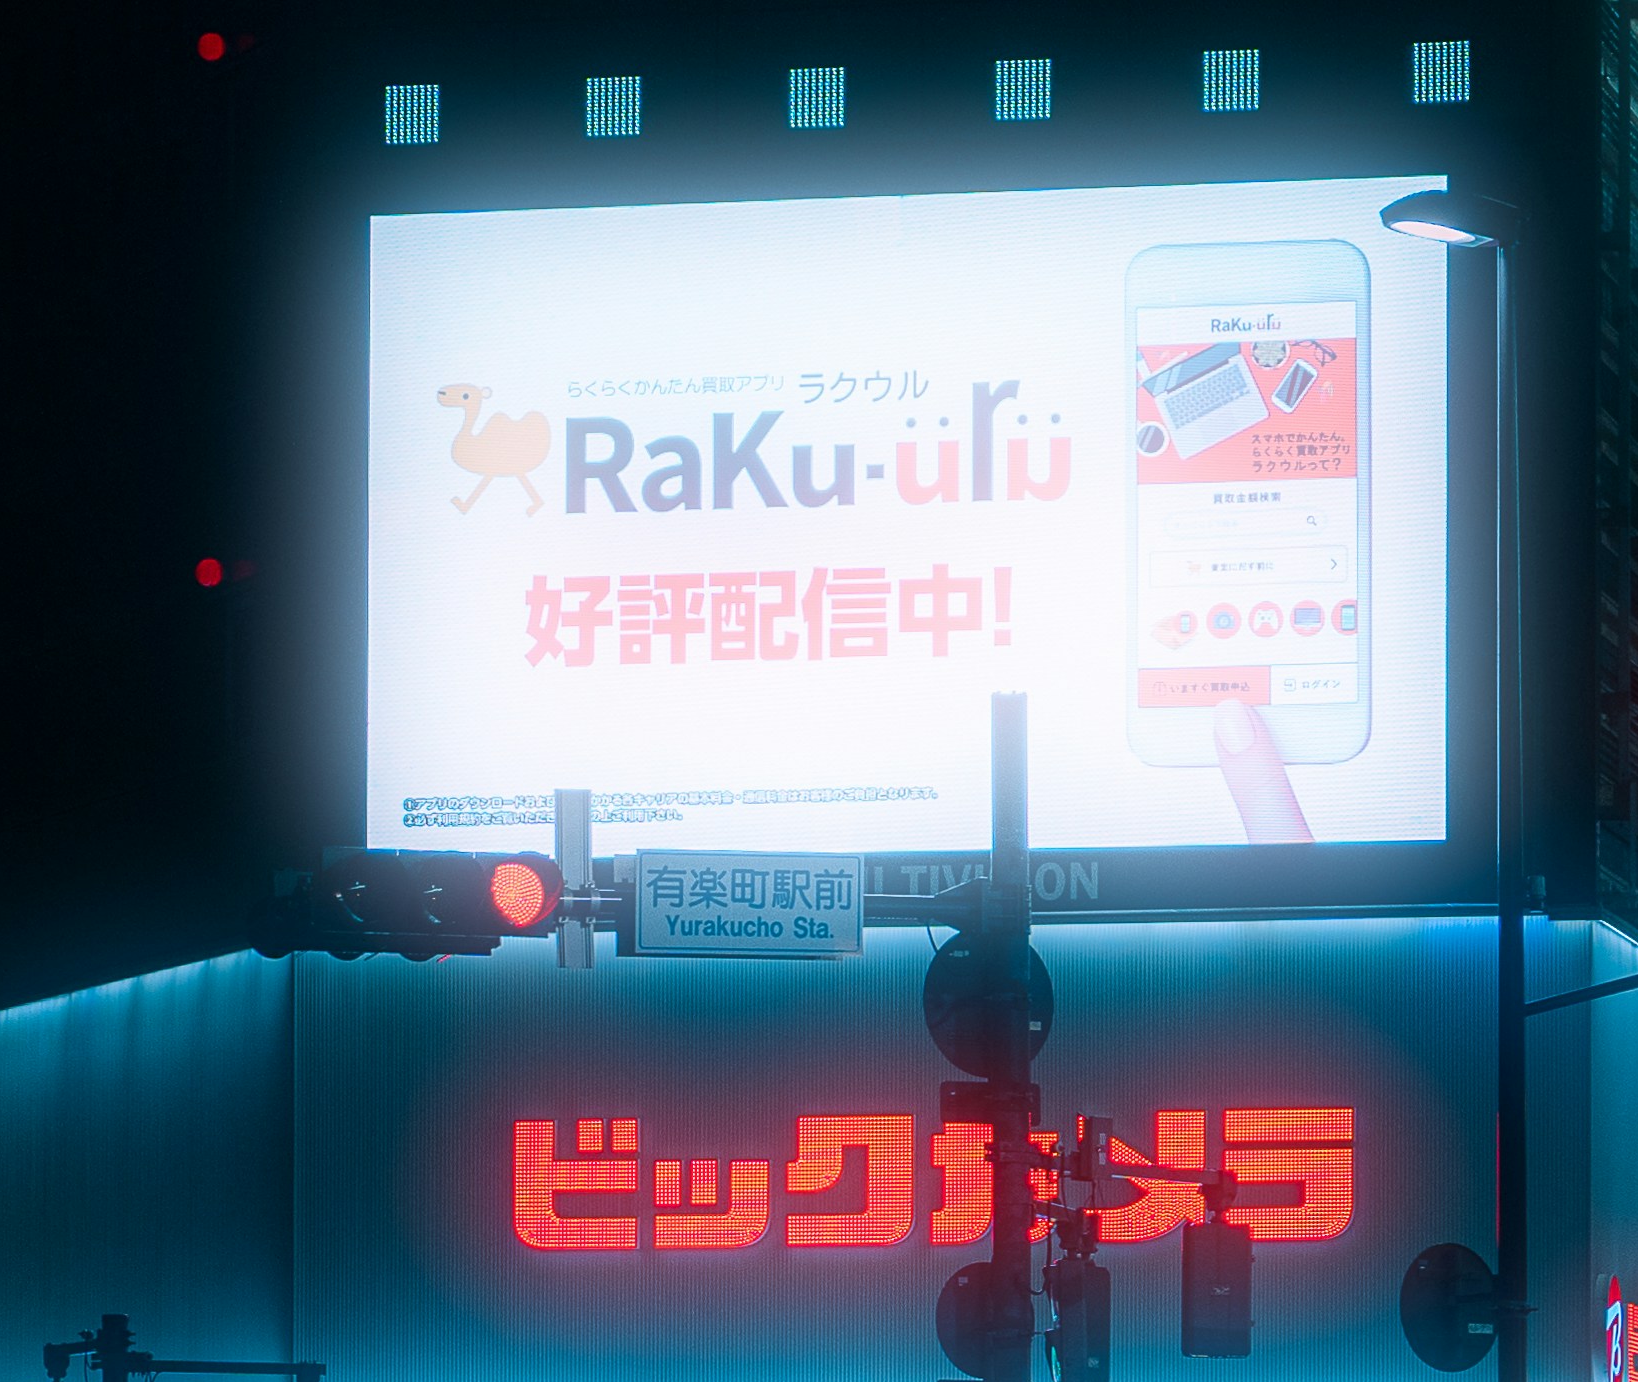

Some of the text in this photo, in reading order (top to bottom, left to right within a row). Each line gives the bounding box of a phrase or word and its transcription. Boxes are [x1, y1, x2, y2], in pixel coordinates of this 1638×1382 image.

[566, 370, 930, 404] らくらくかんたん買取アプリ ラクウル
[524, 564, 1013, 668] 好評配信中!
[1302, 679, 1341, 690] ログイン
[646, 864, 854, 912] 有楽町駅前
[665, 914, 835, 939] Yurakucho Sta.
[513, 1107, 1355, 1250] ビックカメラ
